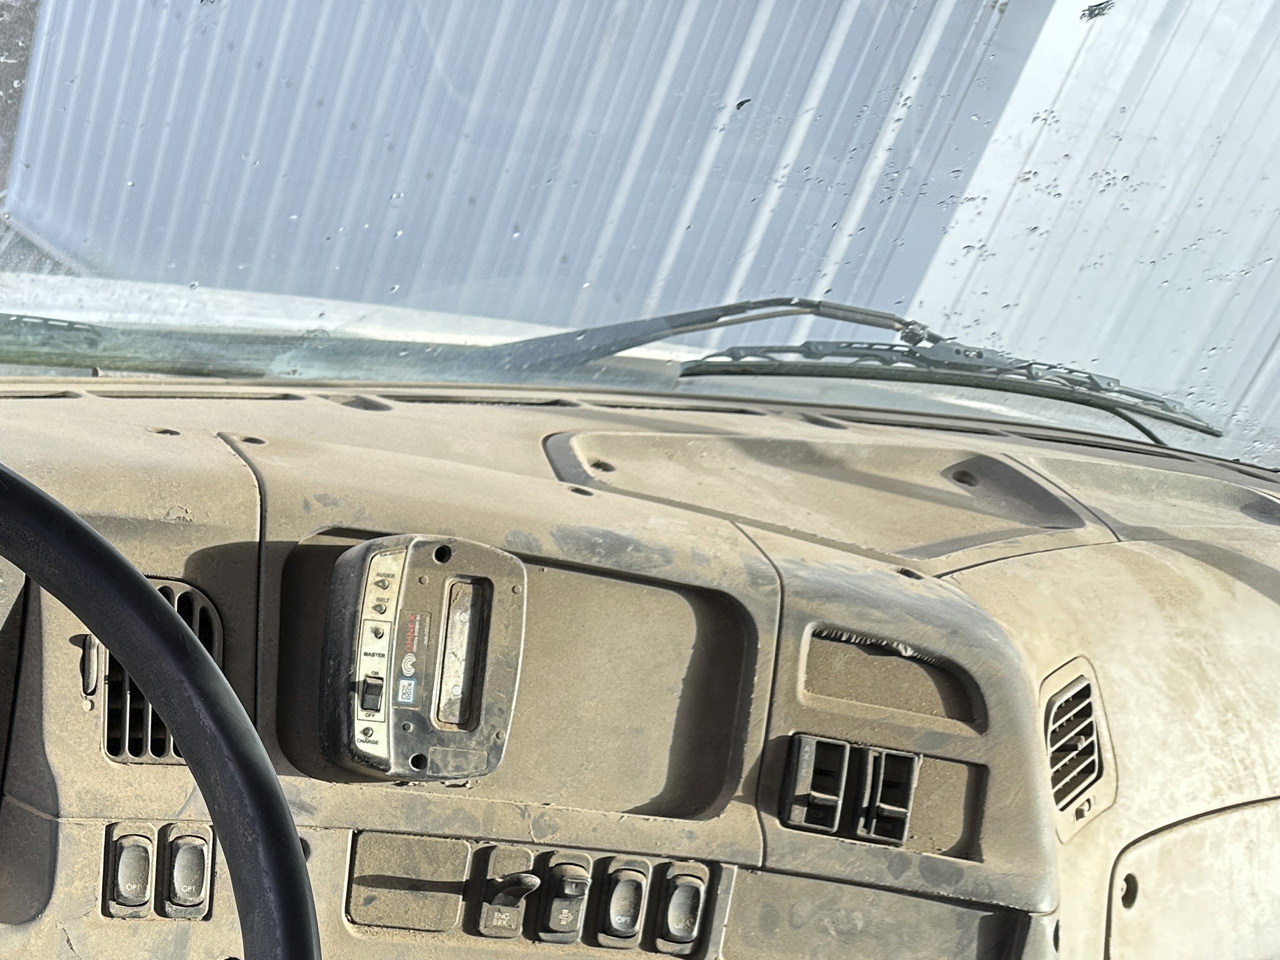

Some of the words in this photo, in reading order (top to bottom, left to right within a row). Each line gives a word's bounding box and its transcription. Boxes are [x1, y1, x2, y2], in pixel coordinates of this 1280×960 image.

[405, 614, 416, 652] OMNEX
[363, 651, 386, 659] MASTER
[181, 885, 196, 893] OPT
[494, 912, 510, 920] ENG
[616, 915, 631, 924] OPT
[493, 918, 508, 927] BRK
